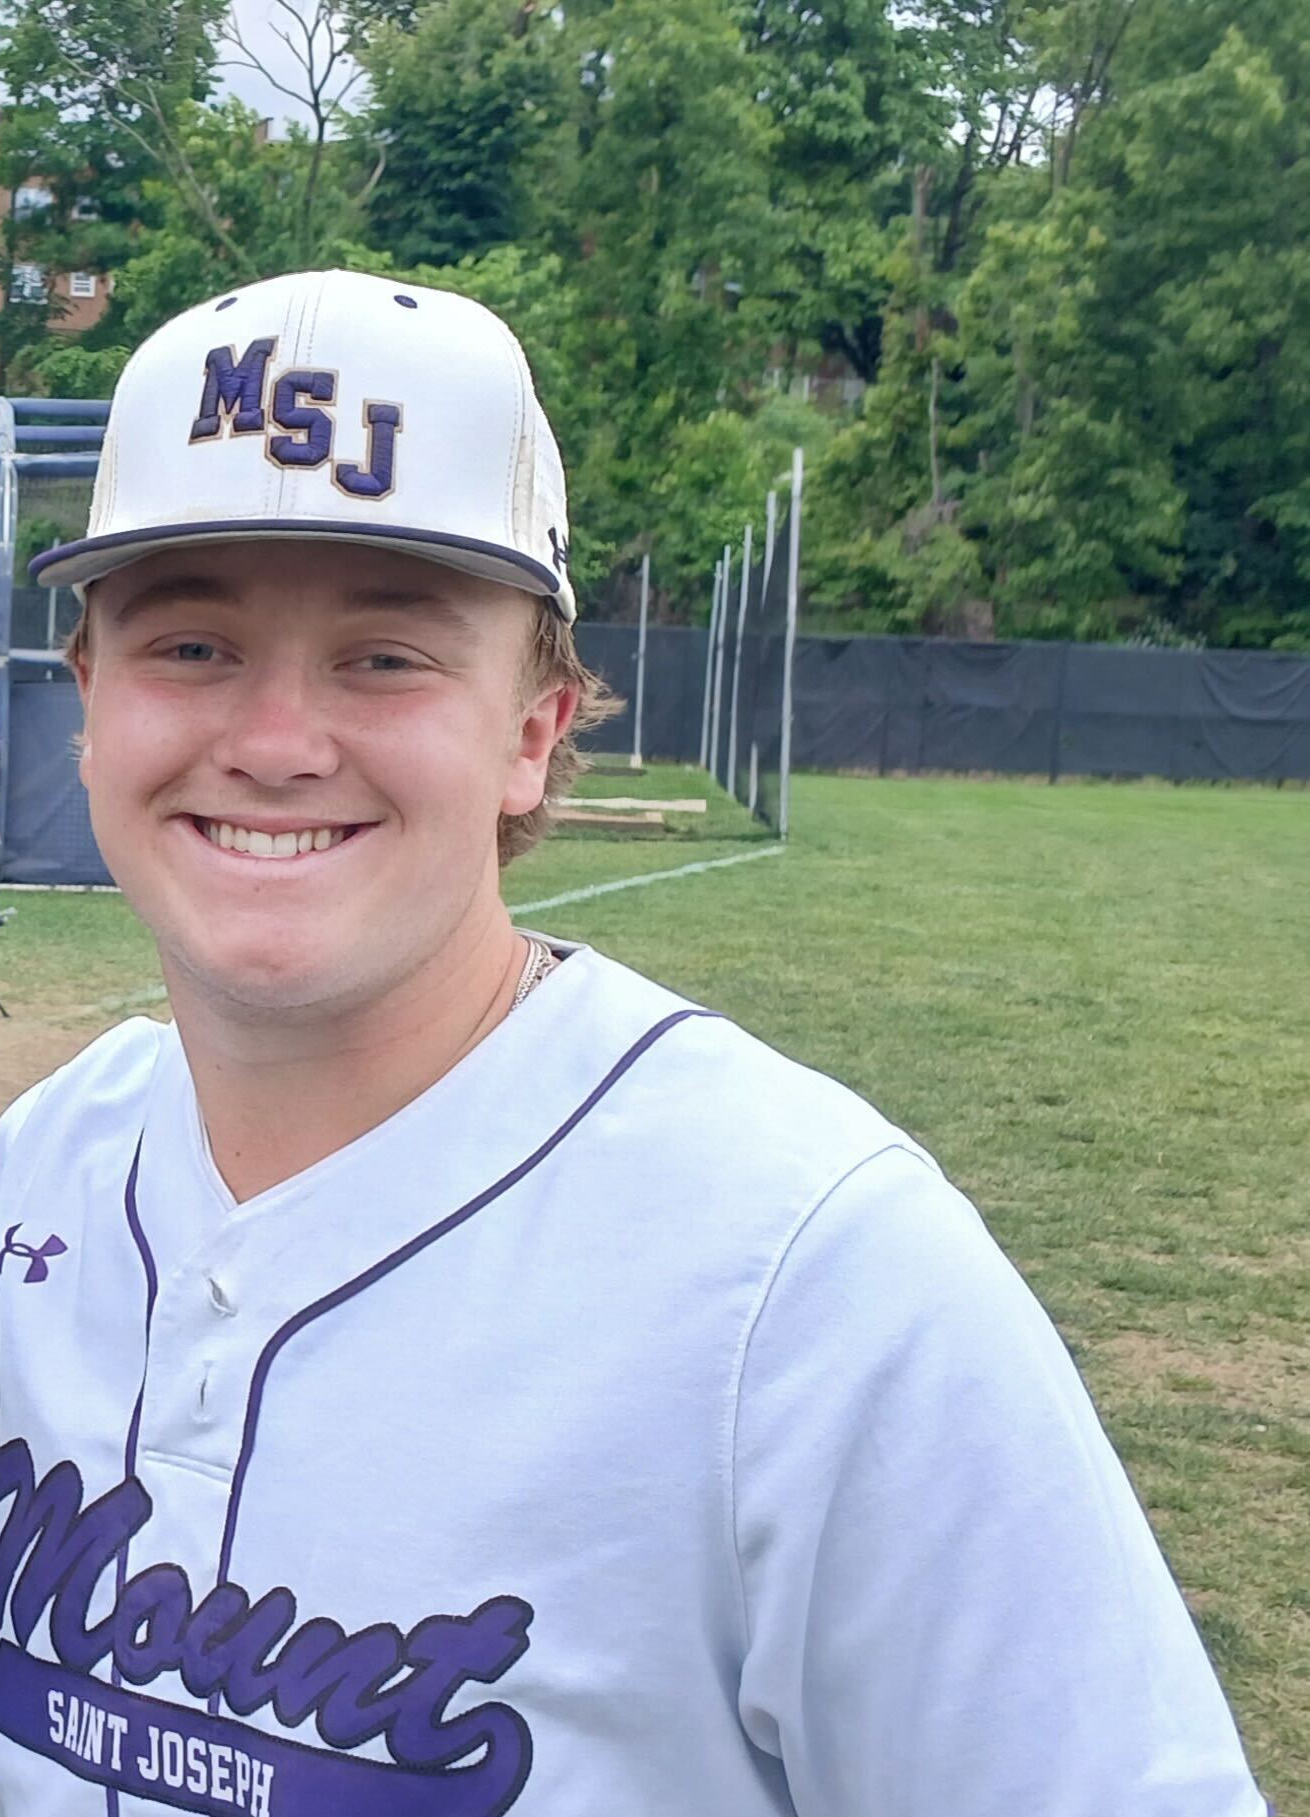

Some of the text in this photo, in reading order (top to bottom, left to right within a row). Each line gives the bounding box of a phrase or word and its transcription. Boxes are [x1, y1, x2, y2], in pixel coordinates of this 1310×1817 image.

[189, 335, 405, 500] MSJ
[47, 1689, 275, 1817] SAINT JOSEPH
